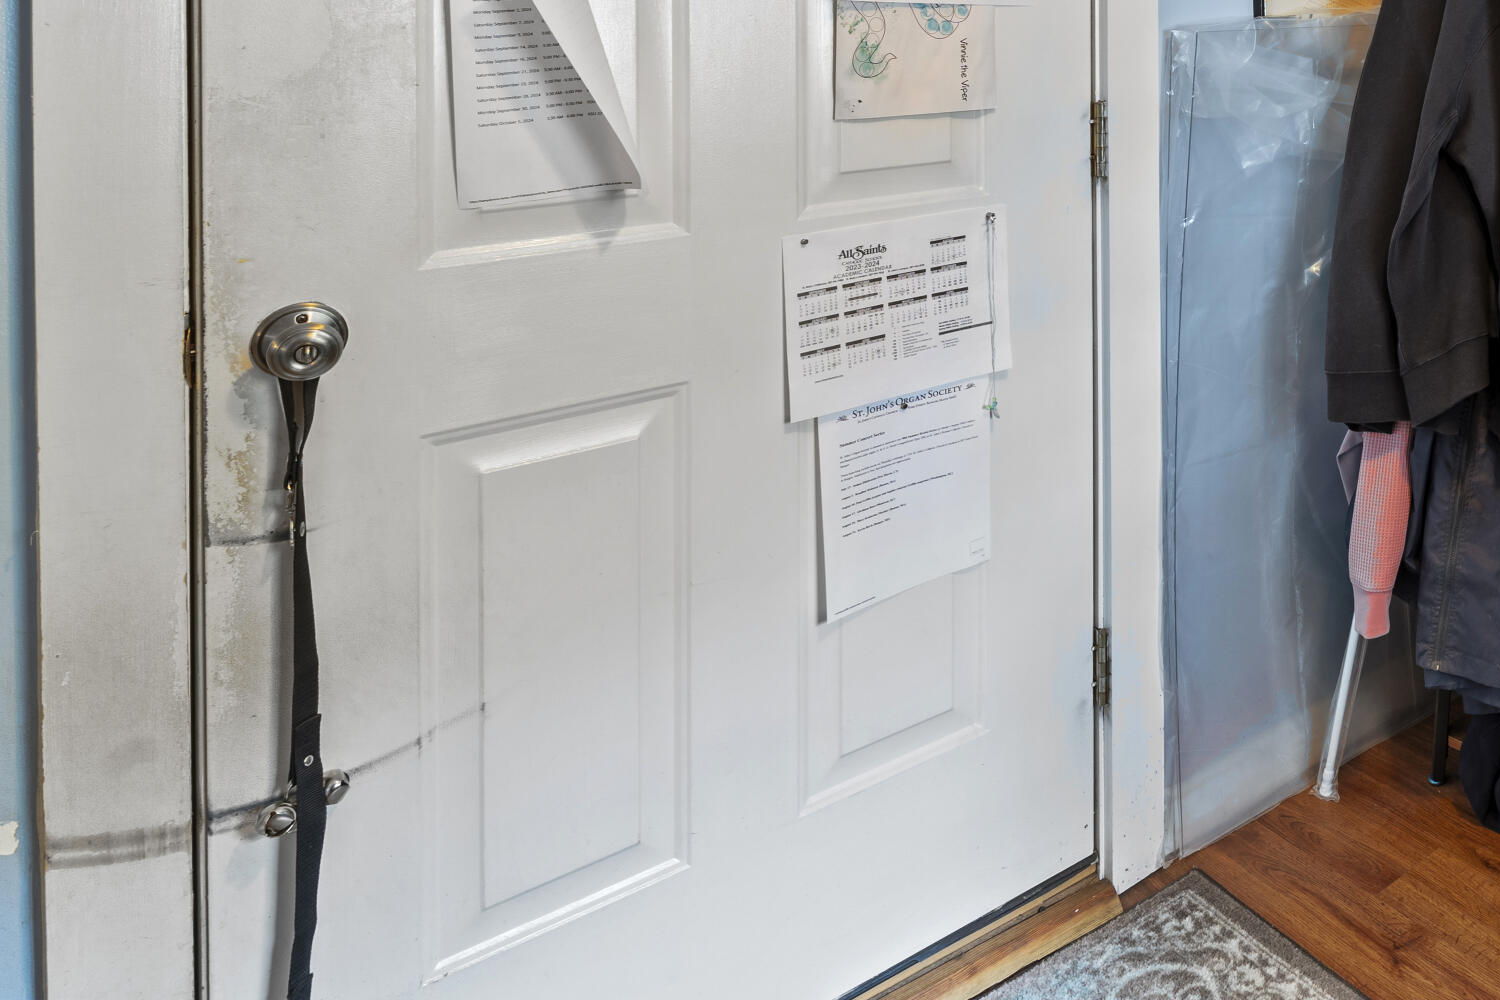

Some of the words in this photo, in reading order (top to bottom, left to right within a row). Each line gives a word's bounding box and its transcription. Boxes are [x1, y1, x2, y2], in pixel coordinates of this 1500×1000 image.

[959, 37, 968, 64] Vinnie
[960, 64, 968, 78] the
[961, 80, 970, 102] Viper
[853, 244, 887, 260] Saints
[834, 270, 862, 279] ACADEMIC
[928, 385, 962, 398] SOCIETY
